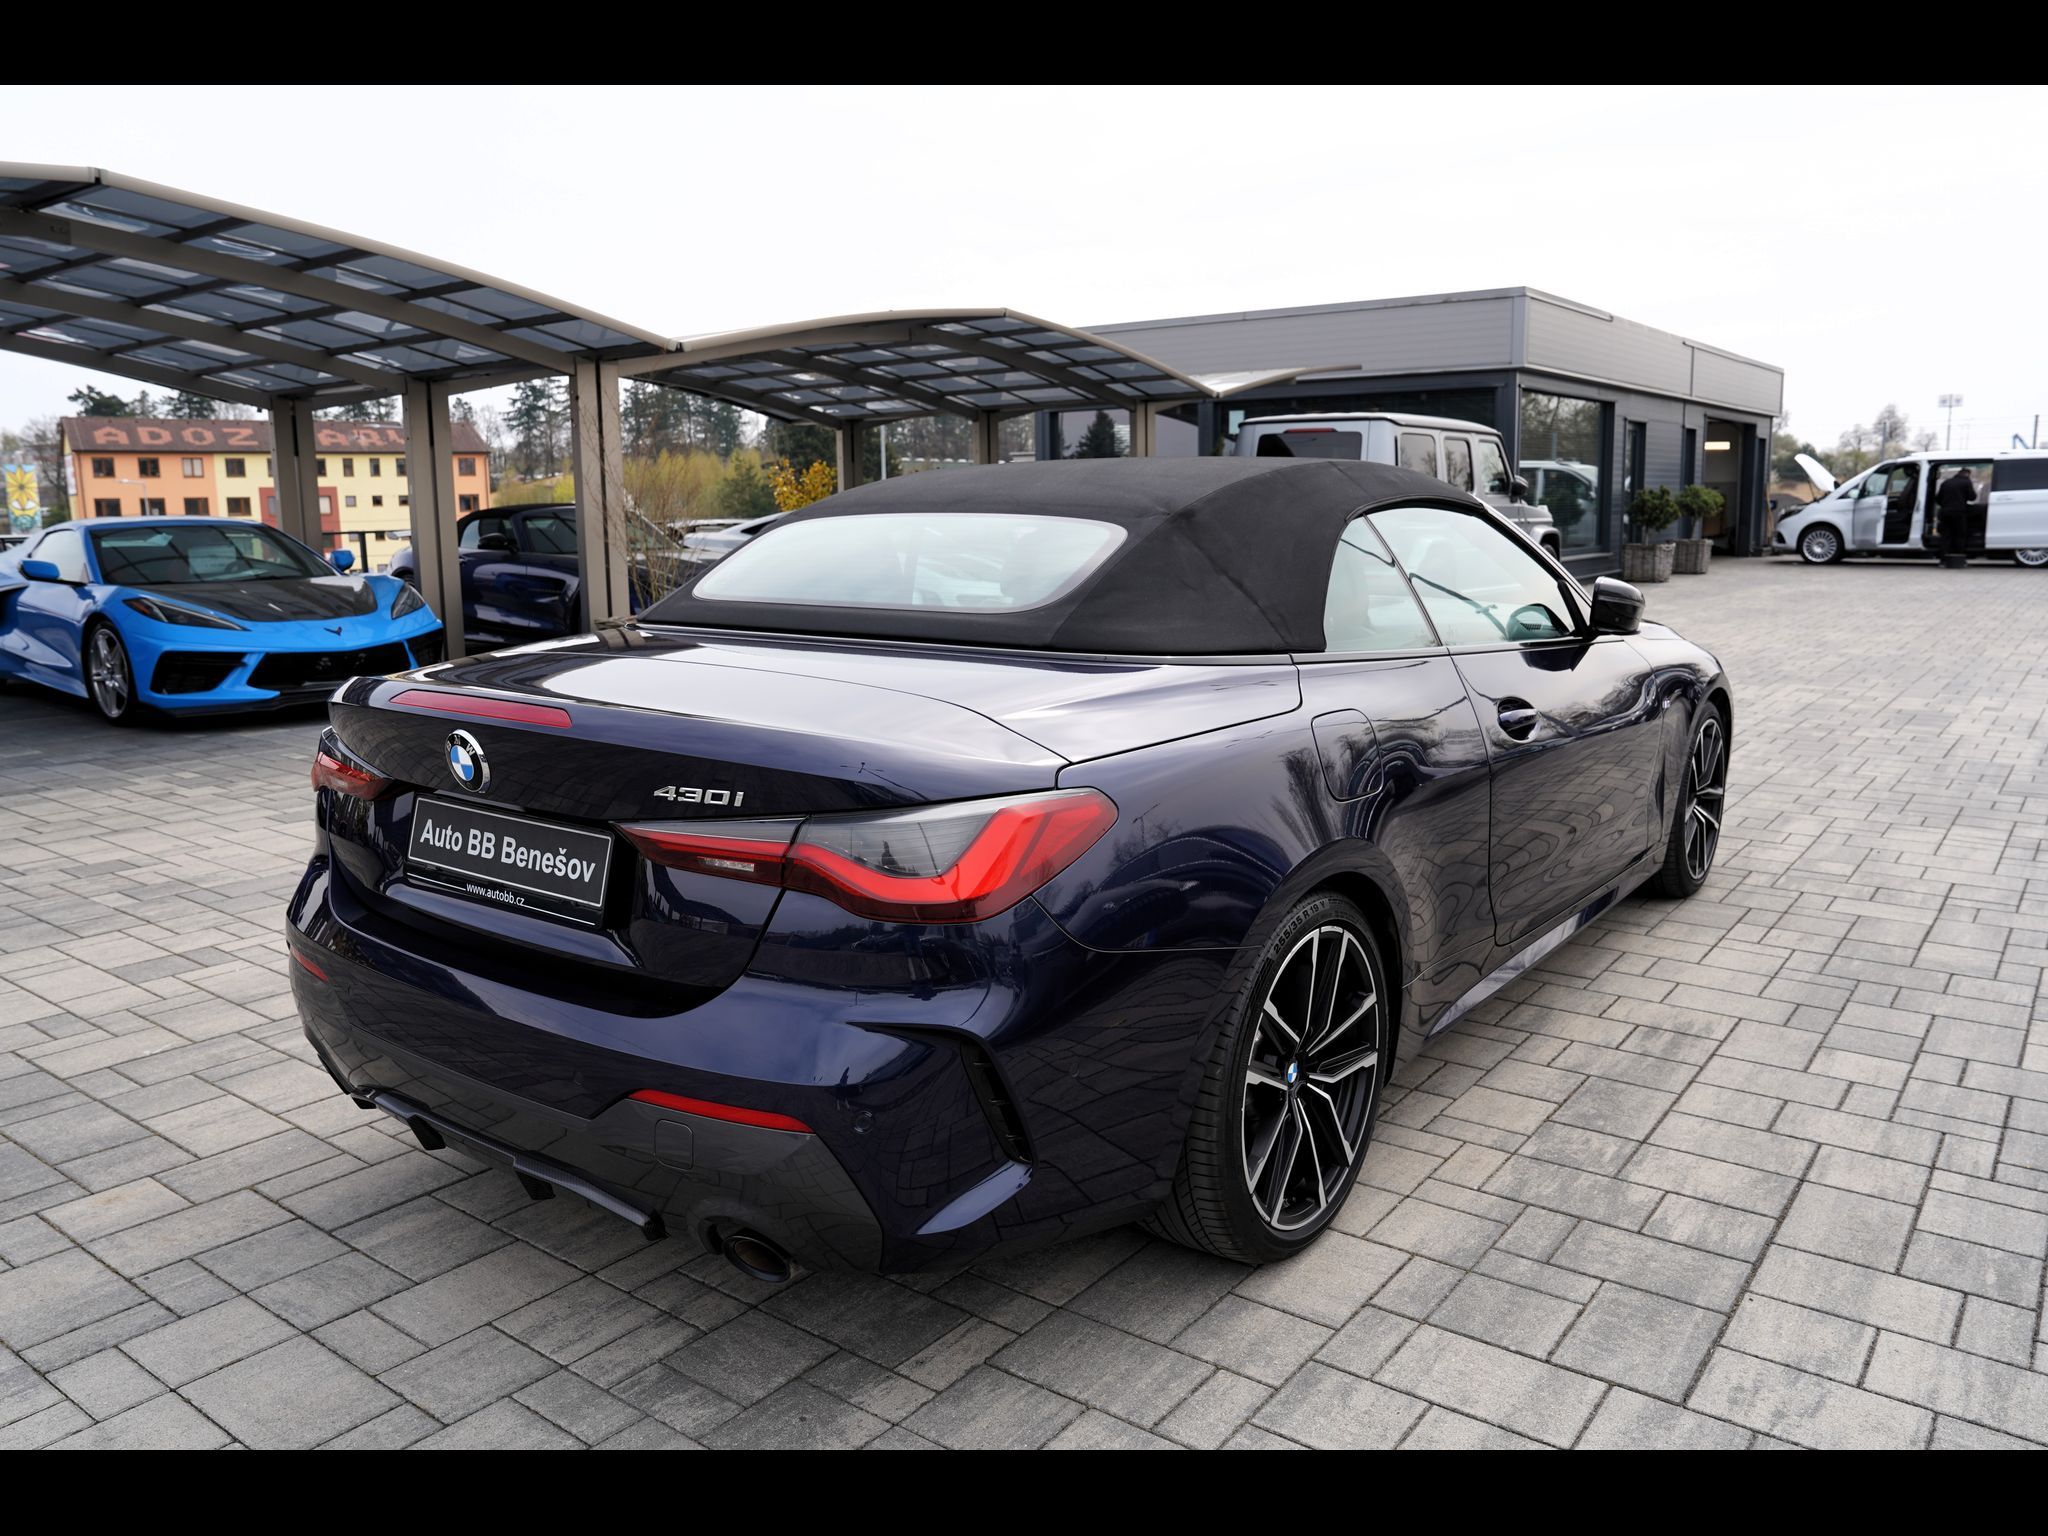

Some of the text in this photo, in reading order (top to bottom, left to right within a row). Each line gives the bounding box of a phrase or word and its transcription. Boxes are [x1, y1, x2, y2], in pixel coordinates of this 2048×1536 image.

[446, 735, 476, 757] BMW
[420, 819, 596, 882] Auto BB Benešov
[466, 883, 525, 906] www.autobb.cz
[1273, 916, 1303, 954] 255/35
[1302, 910, 1310, 919] R
[1310, 904, 1319, 914] 19
